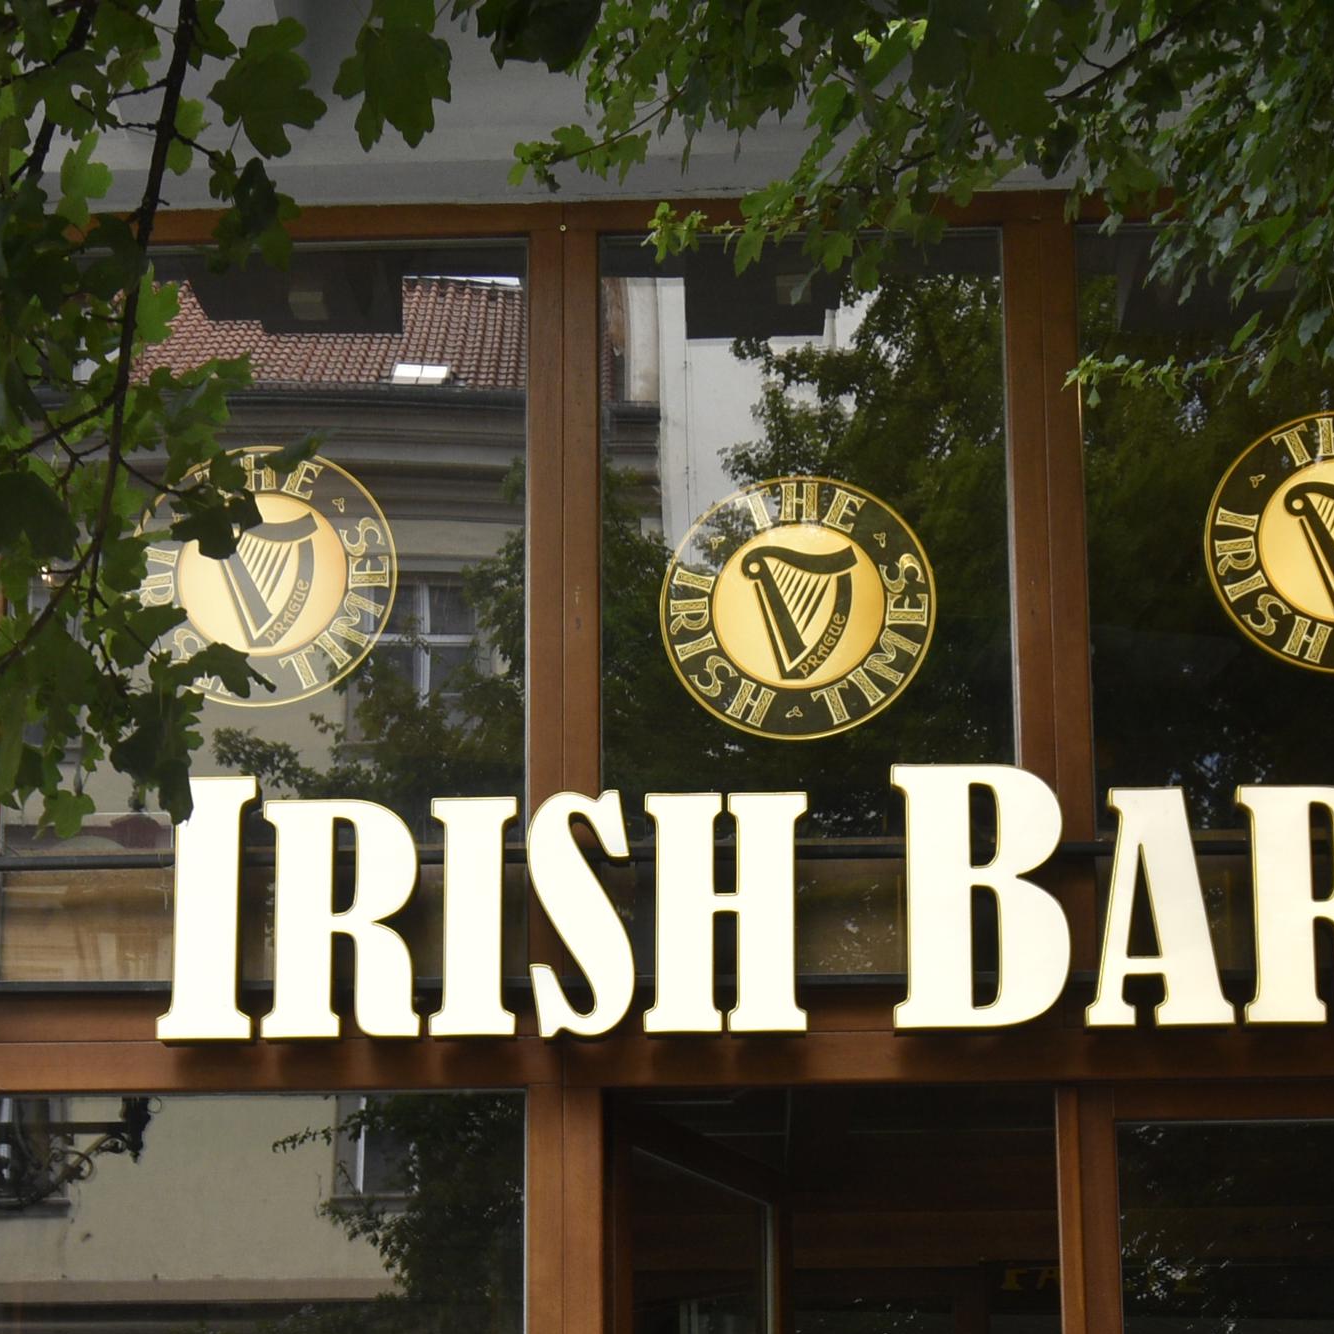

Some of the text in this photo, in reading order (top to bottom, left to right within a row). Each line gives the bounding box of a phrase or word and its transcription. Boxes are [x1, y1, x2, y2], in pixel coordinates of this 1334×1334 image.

[194, 453, 324, 500] HE
[735, 482, 866, 533] THE
[279, 517, 390, 690] TIMES
[670, 552, 929, 728] IRISH TIMES
[1214, 507, 1334, 664] IRISH
[155, 774, 809, 1042] IRISH
